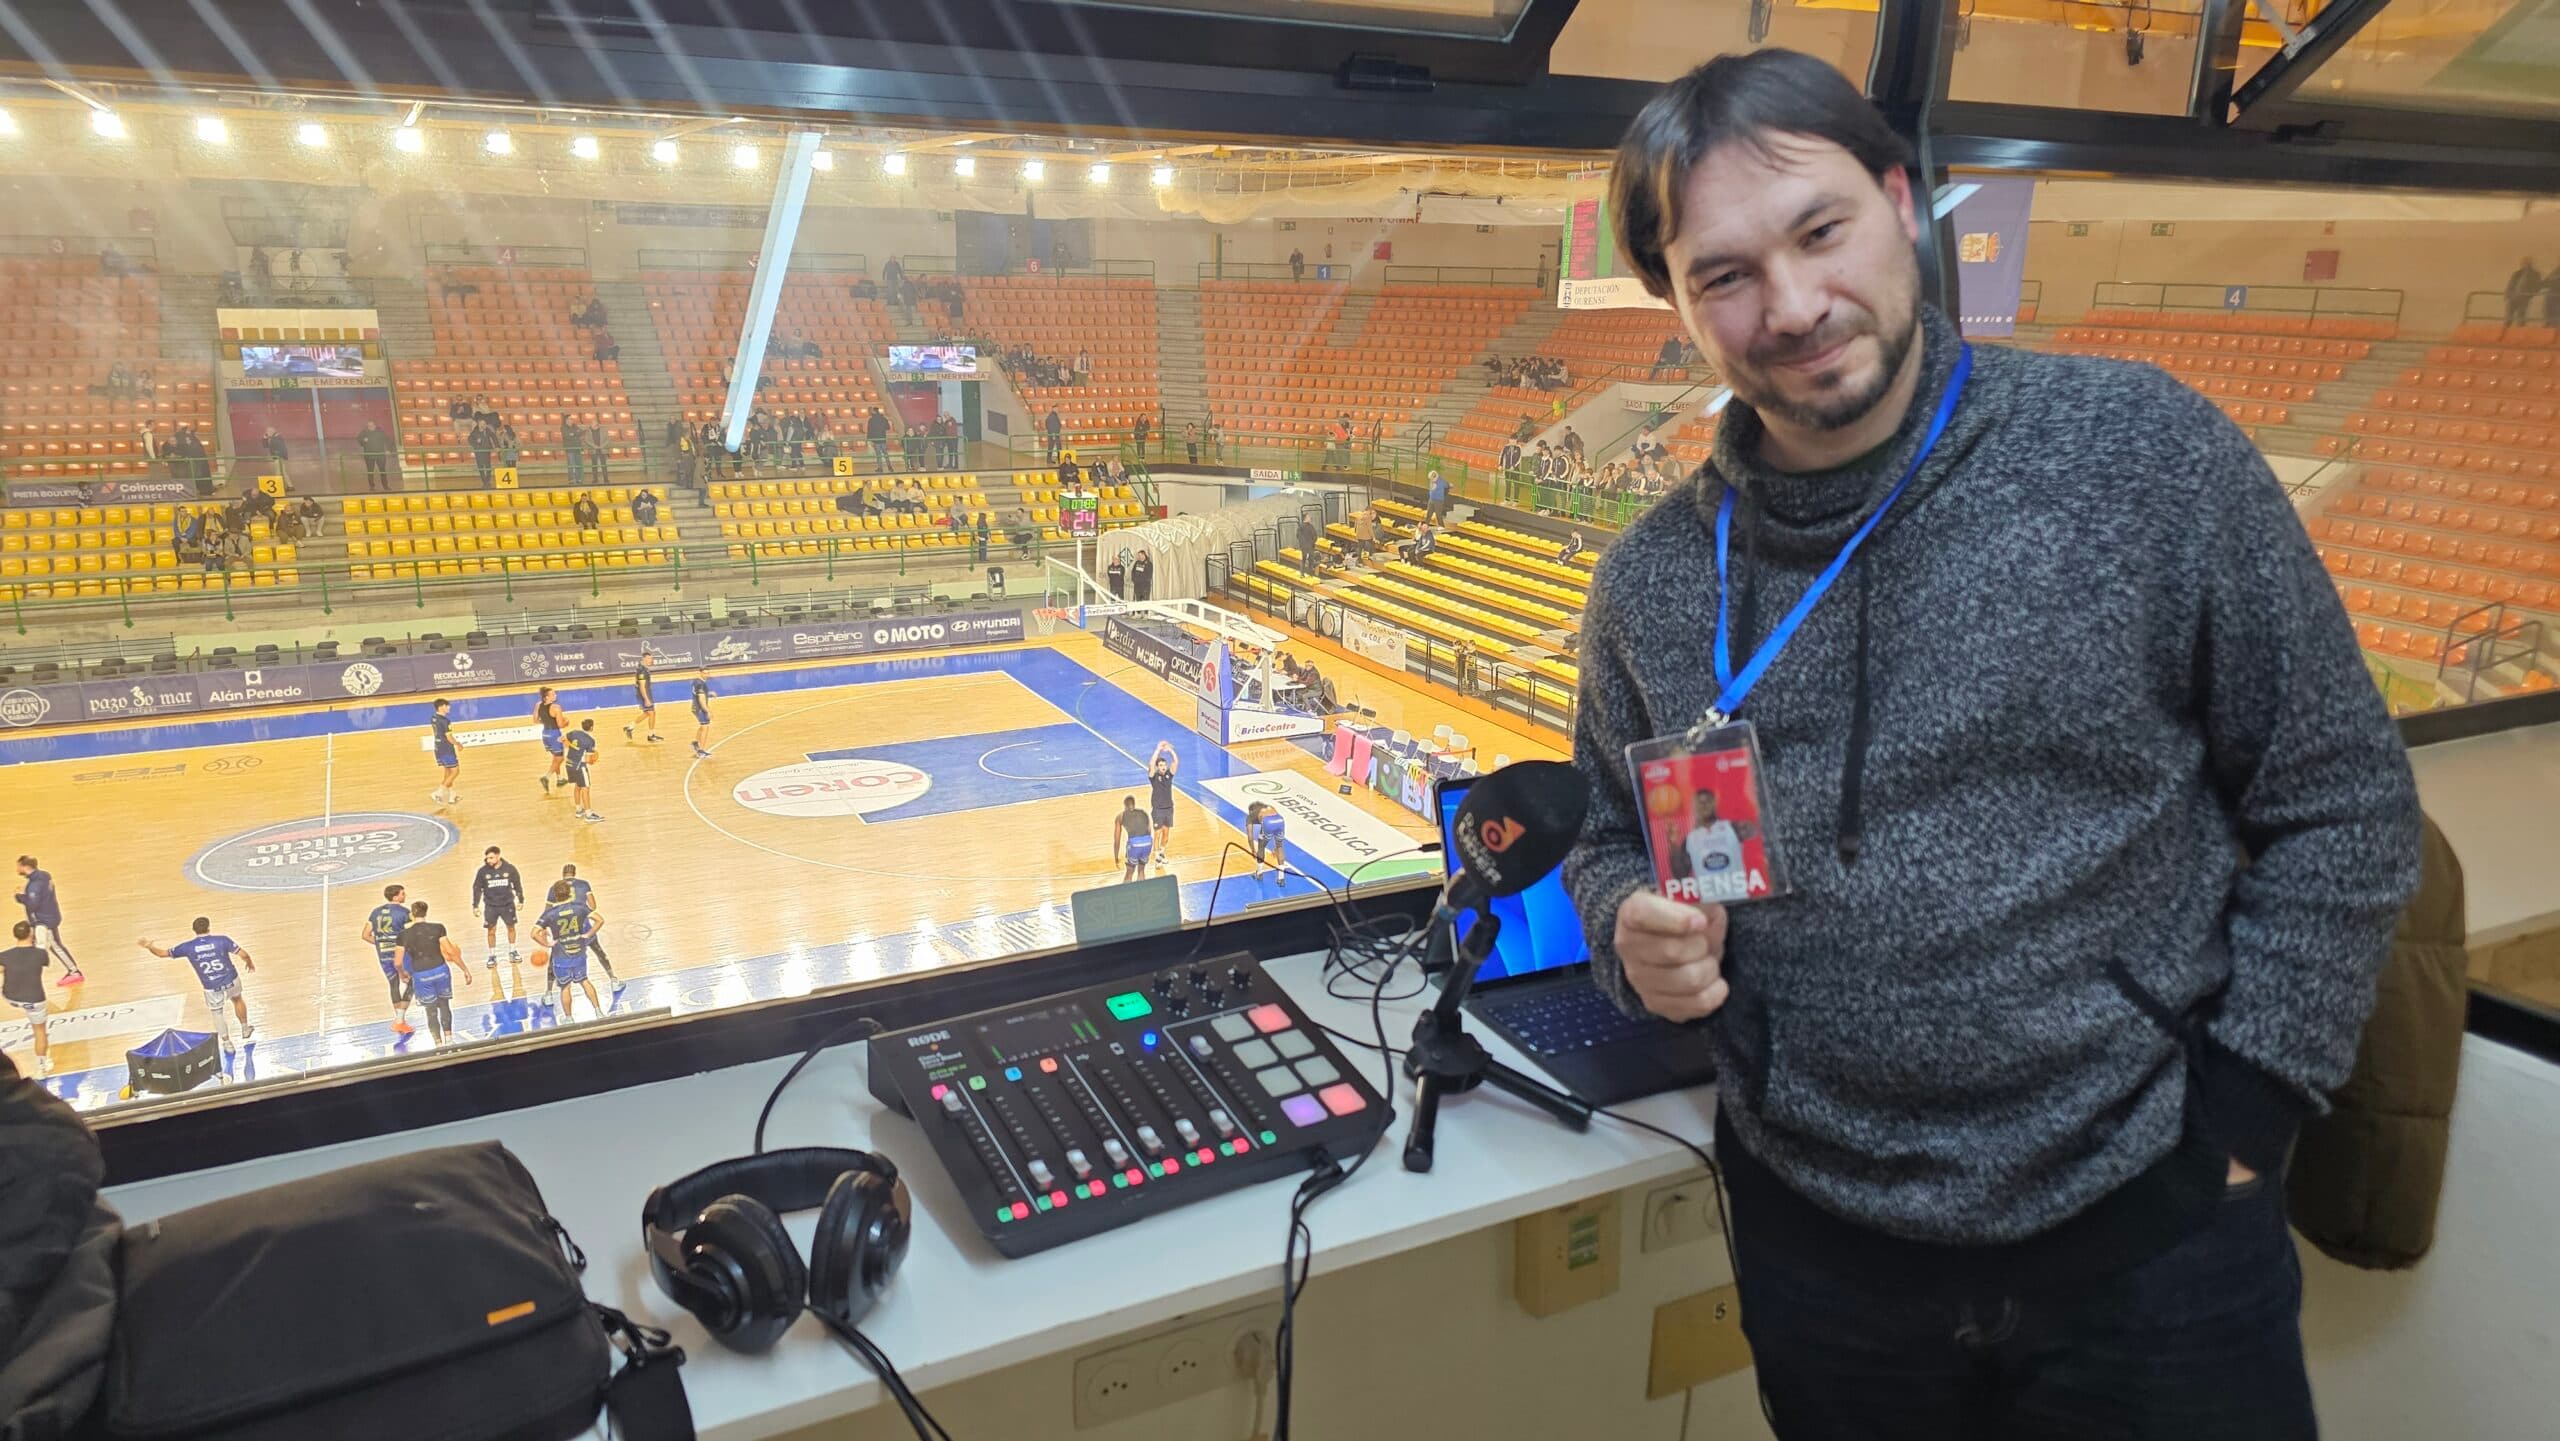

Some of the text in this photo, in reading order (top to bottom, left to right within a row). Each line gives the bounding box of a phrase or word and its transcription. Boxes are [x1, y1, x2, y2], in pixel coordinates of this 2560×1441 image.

[2229, 288, 2241, 306] 4
[838, 460, 847, 473] 5
[266, 480, 278, 494] 3
[501, 471, 513, 485] 4
[120, 482, 185, 493] Coinscrap
[1073, 511, 1096, 530] 24
[972, 617, 1021, 630] HYUNDAI
[890, 624, 945, 644] MOTO
[556, 660, 604, 674] low cost
[90, 697, 128, 714] pazo
[160, 690, 193, 705] mar
[209, 690, 244, 703] Alán
[246, 686, 302, 699] Penedo
[1241, 722, 1297, 736] BricoCentro
[1273, 794, 1379, 857] IBEREÓLICA
[256, 830, 399, 855] Galicia
[247, 838, 405, 867] Estrella
[1664, 868, 1767, 903] PRENSA
[556, 915, 579, 936] 24
[199, 958, 224, 974] 25
[1715, 1302, 1727, 1320] 5
